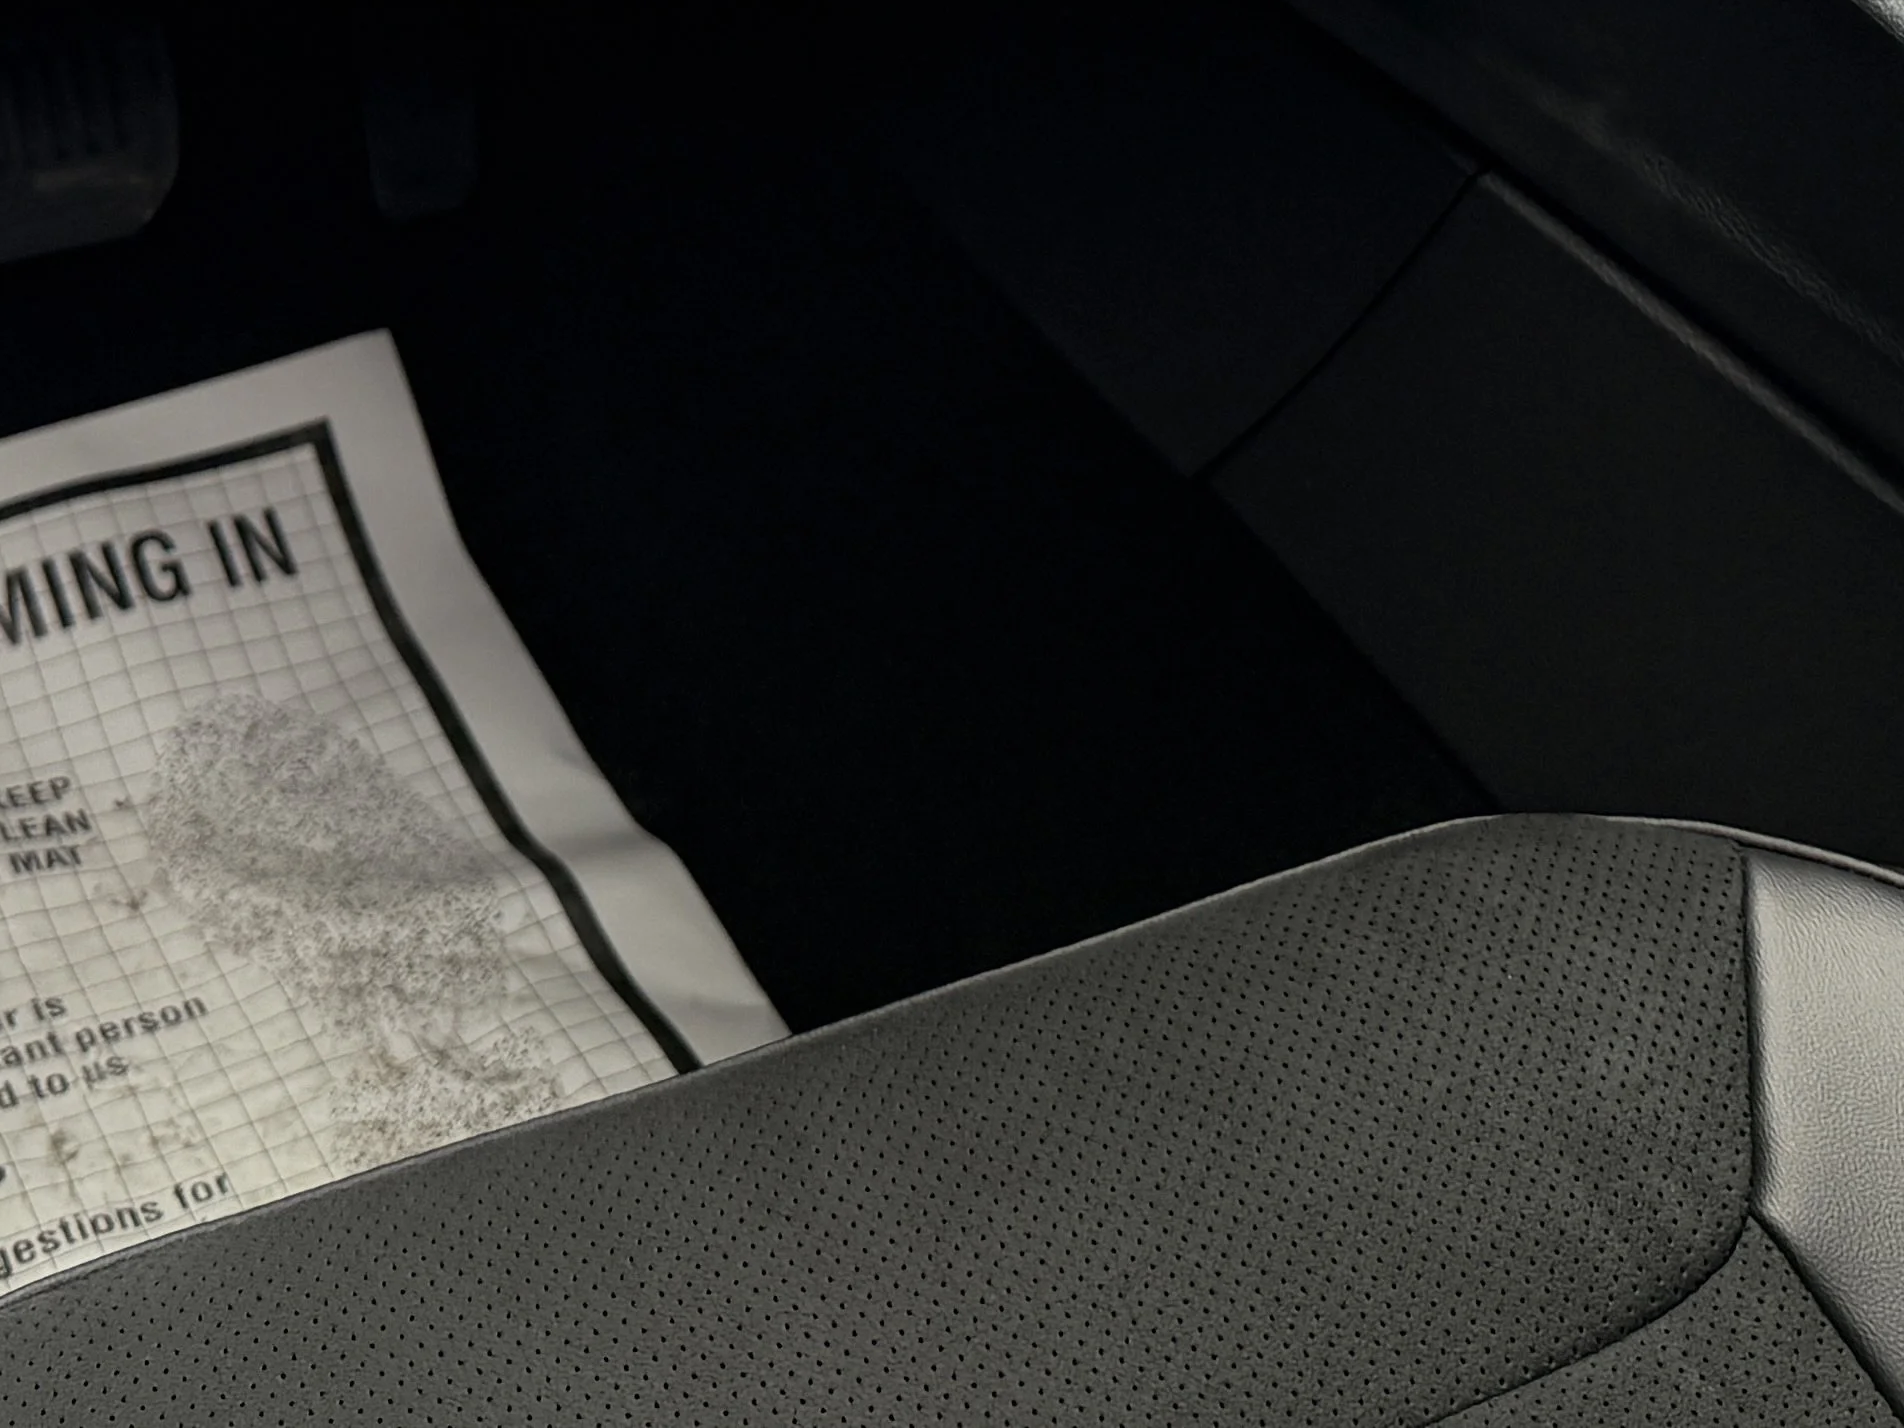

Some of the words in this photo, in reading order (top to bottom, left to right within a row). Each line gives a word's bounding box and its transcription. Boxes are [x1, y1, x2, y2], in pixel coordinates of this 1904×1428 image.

[207, 505, 299, 587] IN
[10, 843, 86, 878] MAT
[30, 994, 68, 1022] is
[74, 994, 209, 1053] person
[27, 1069, 70, 1101] to
[81, 1052, 131, 1086] us
[172, 1171, 234, 1211] for
